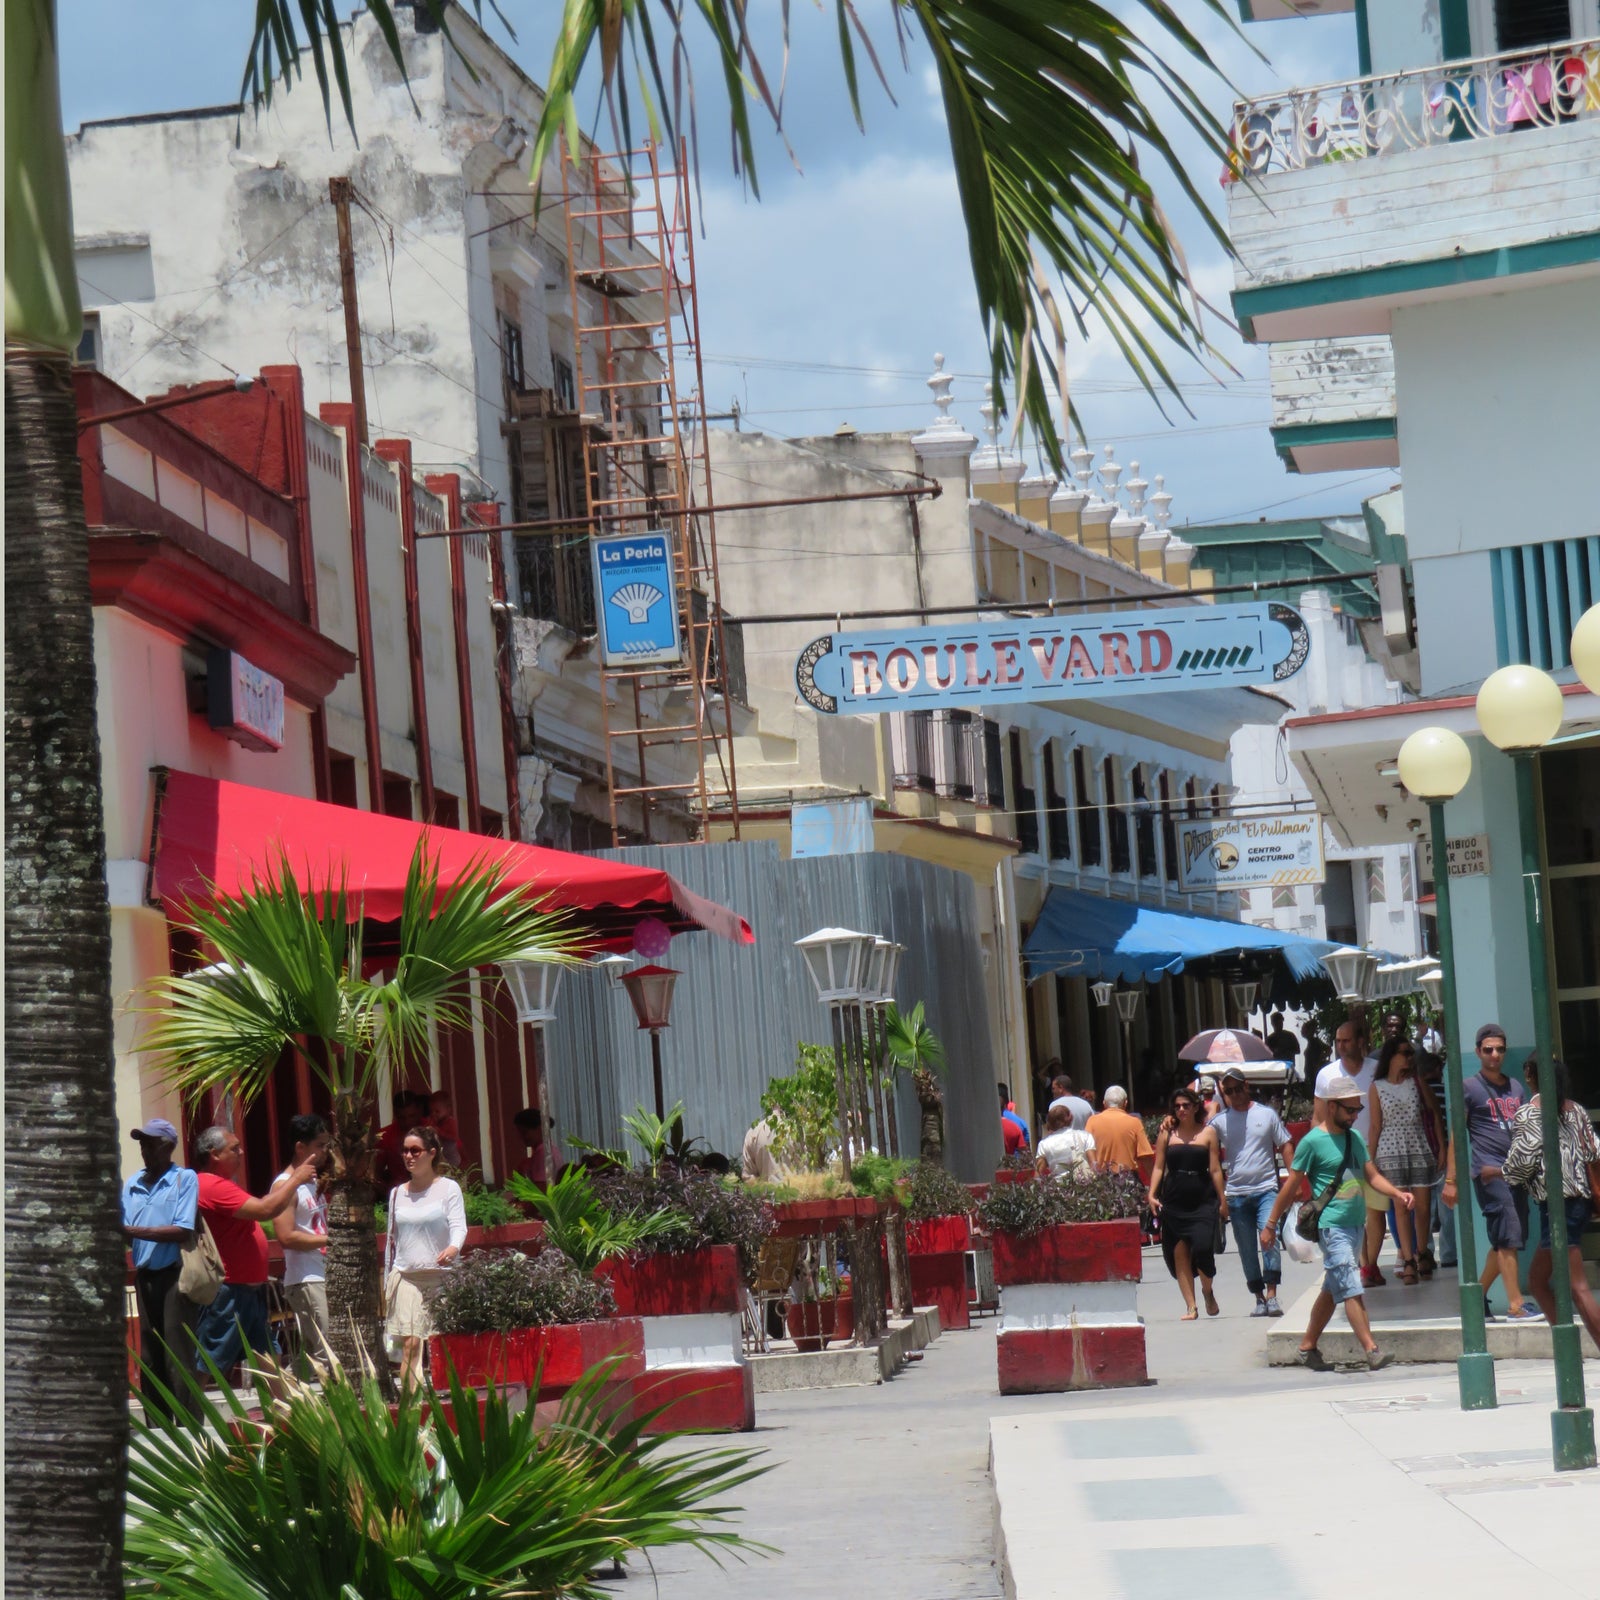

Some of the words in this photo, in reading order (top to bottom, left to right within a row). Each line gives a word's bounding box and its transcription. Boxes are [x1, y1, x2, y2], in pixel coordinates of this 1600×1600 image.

[602, 549, 621, 562] La
[624, 545, 663, 560] Perla
[848, 629, 1173, 696] BOULEVARD
[1247, 846, 1281, 855] CENTRO
[1425, 838, 1477, 852] PHIBIDO
[1248, 853, 1295, 863] NOCTURNO
[1464, 849, 1483, 860] CON
[1447, 862, 1485, 875] ICLETAS
